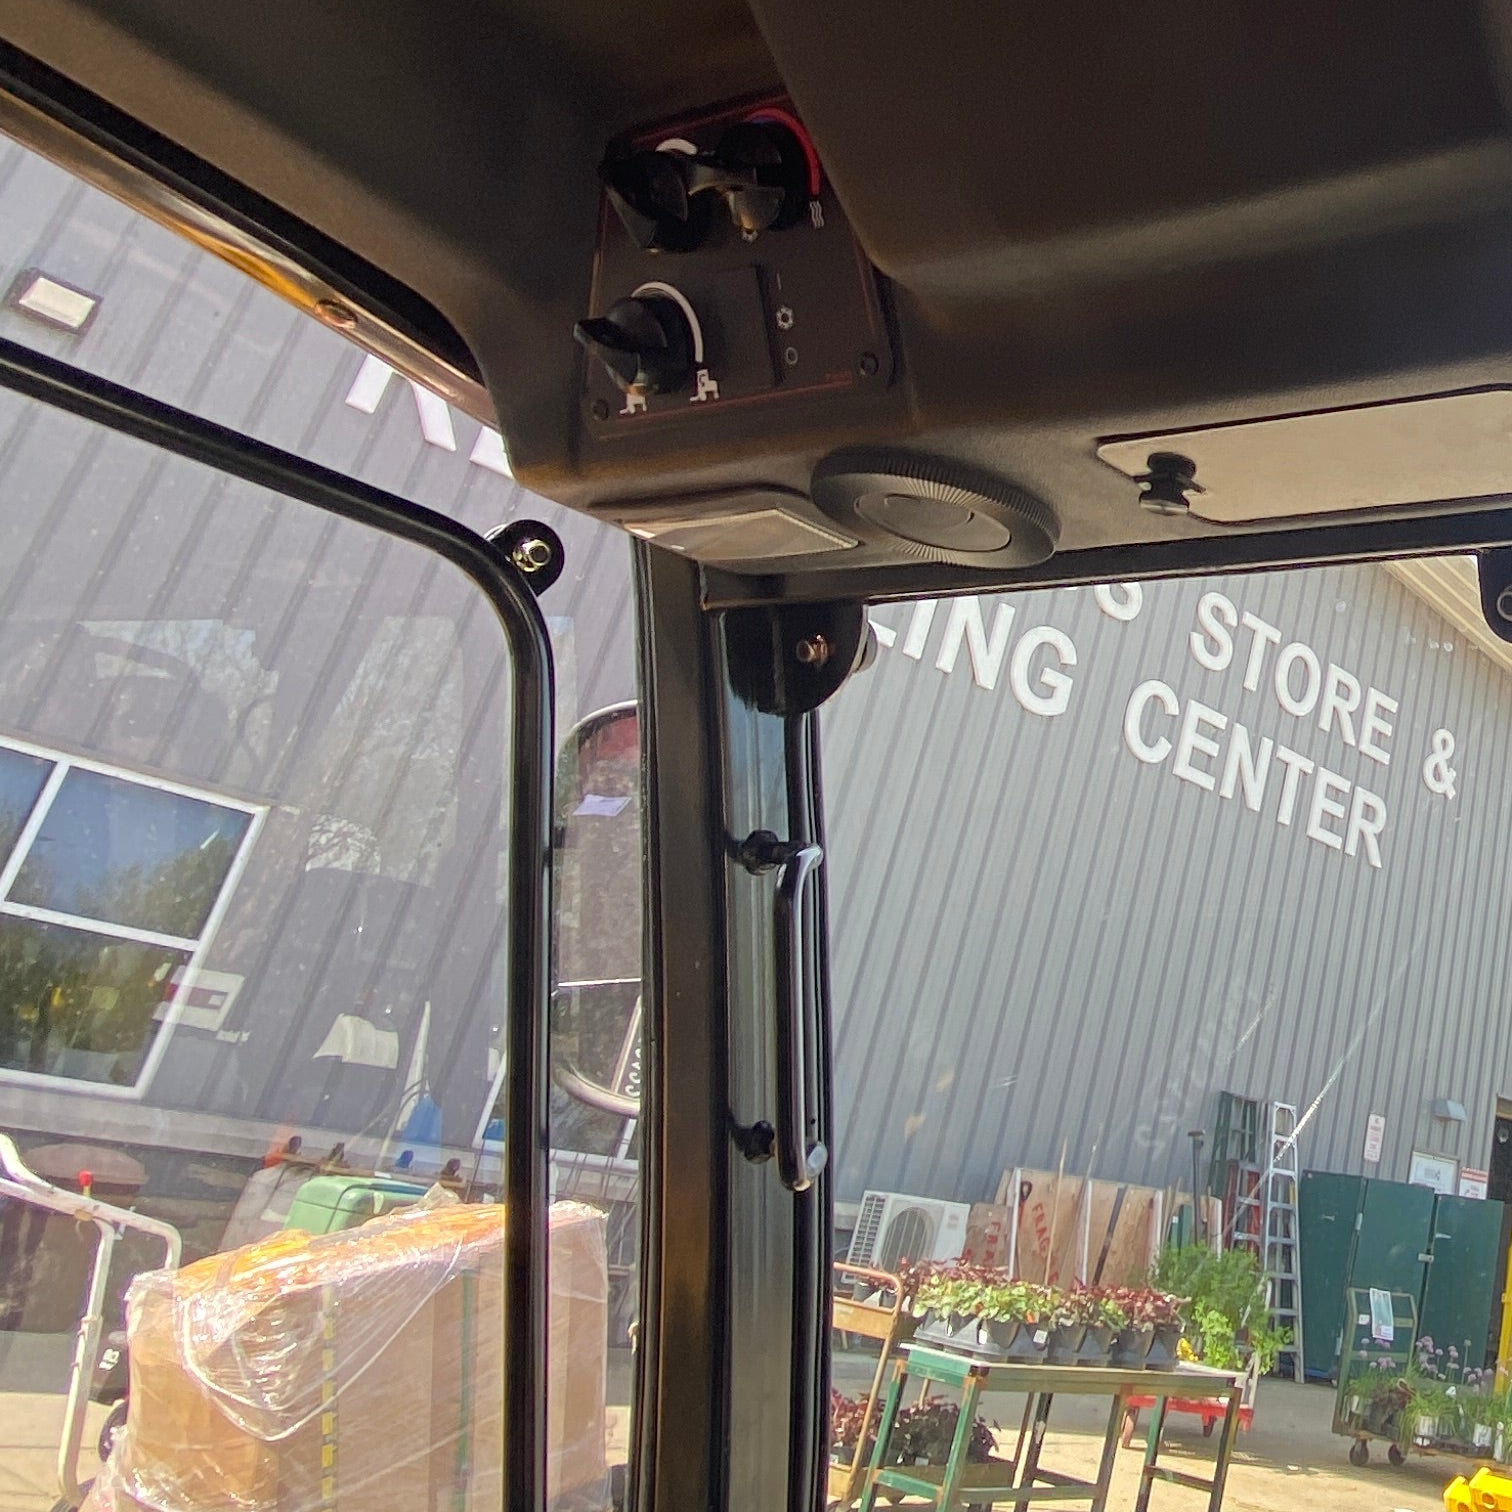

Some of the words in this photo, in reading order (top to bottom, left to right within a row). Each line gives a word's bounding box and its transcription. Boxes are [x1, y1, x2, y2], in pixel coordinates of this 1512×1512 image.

[868, 595, 1077, 717] ING
[1124, 679, 1386, 868] CENTER
[1189, 591, 1399, 765] STORE
[1423, 729, 1456, 800] &
